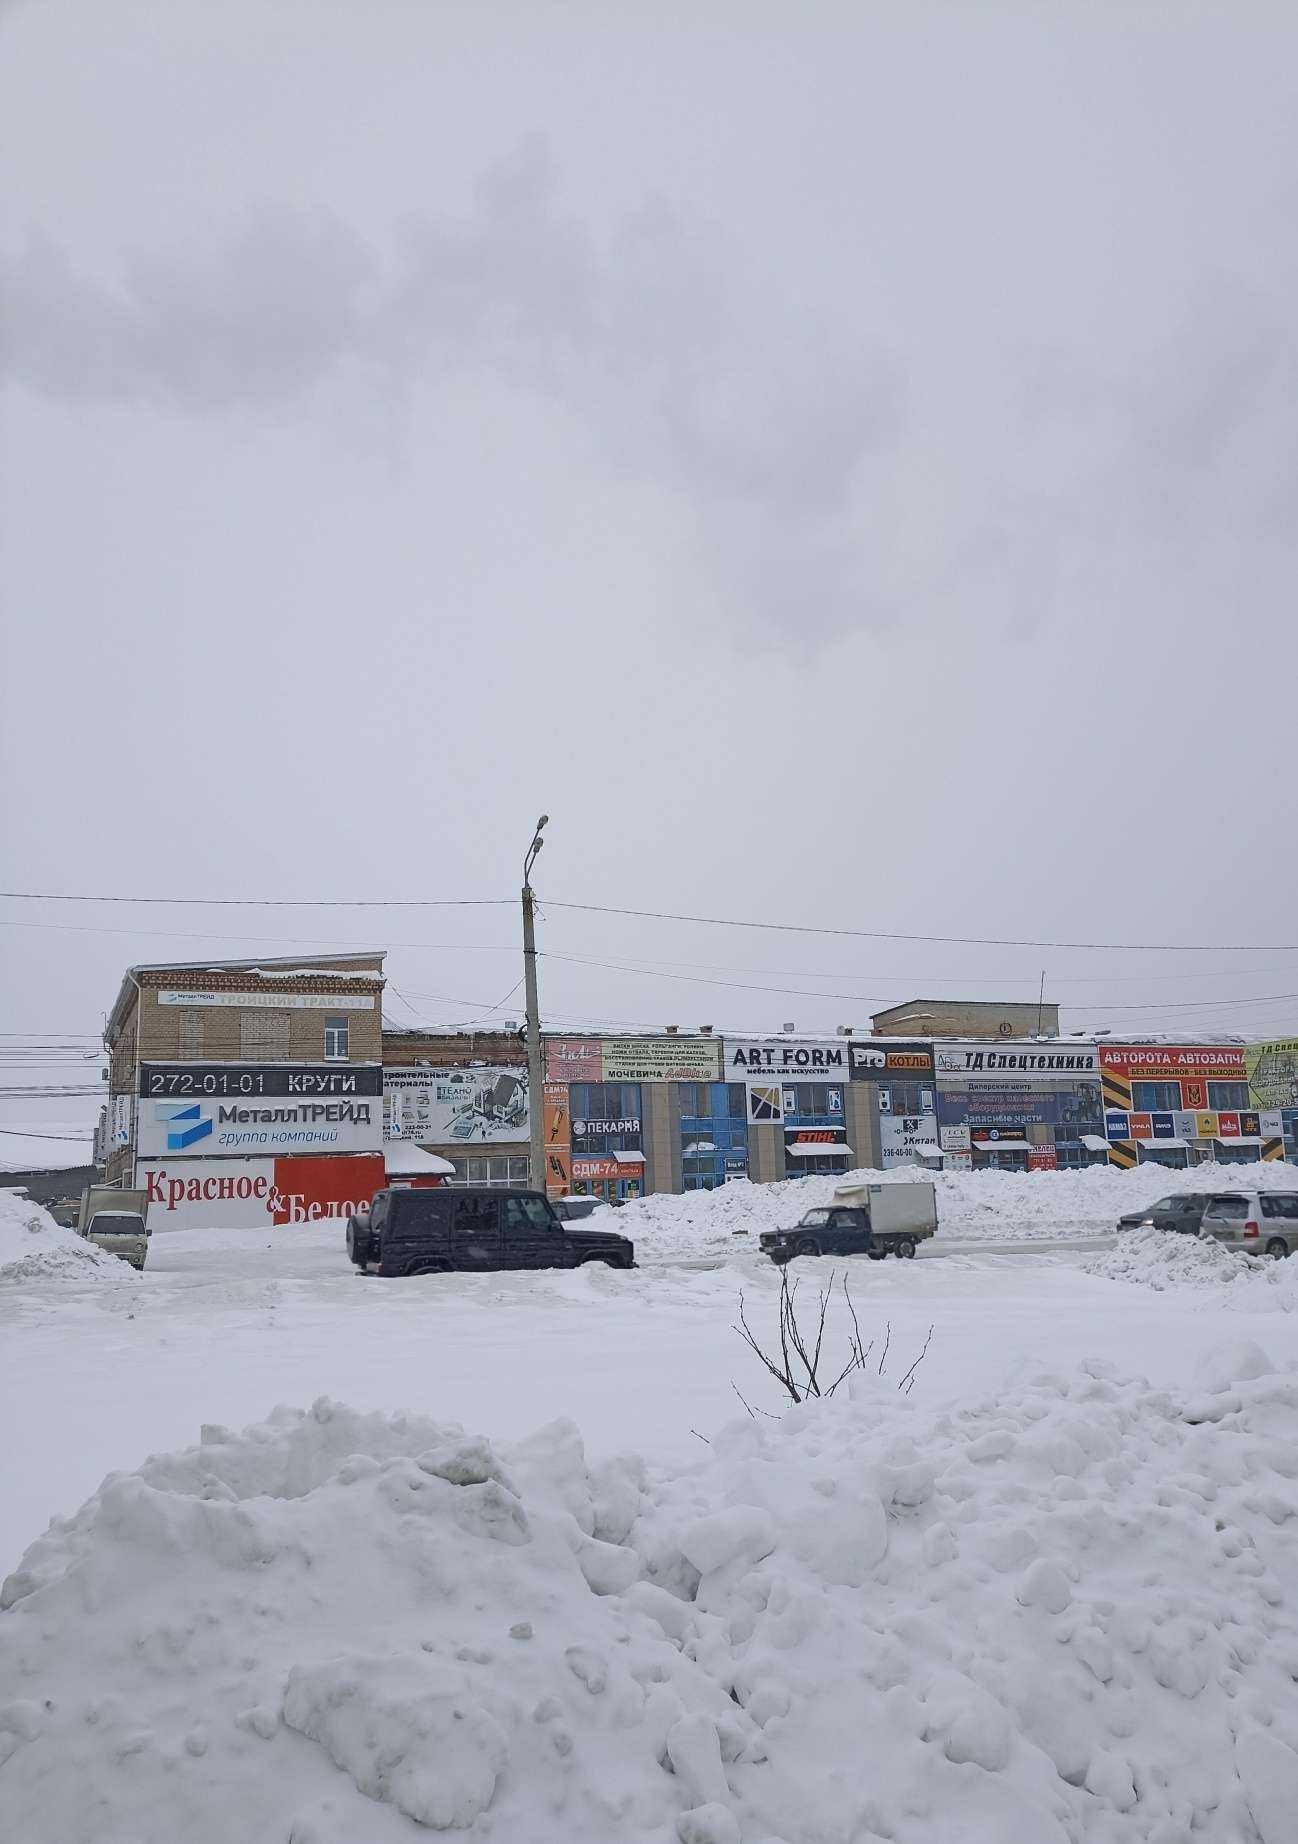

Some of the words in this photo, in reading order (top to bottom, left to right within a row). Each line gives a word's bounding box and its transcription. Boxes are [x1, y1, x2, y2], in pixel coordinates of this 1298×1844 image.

[733, 1049, 775, 1065] ART
[783, 1049, 842, 1066] FORM
[853, 1050, 886, 1068] Pro
[889, 1056, 930, 1067] КОТЛЫ
[966, 1053, 984, 1070] ТД
[988, 1053, 1094, 1070] Спецтехника
[1105, 1052, 1171, 1064] АВТОРОТА
[151, 1075, 264, 1093] 272-01-01
[288, 1076, 356, 1092] КРУГИ
[218, 1102, 371, 1125] МеталлТРЕЙД
[964, 1114, 1012, 1123] Запасные
[1014, 1115, 1042, 1123] части
[588, 1120, 640, 1133] ПЕКАРНЯ
[218, 1131, 267, 1146] группа
[271, 1128, 338, 1143] компаний
[796, 1132, 835, 1143] STIHL
[572, 1163, 618, 1177] СДМ-74
[145, 1171, 268, 1210] Красное
[266, 1186, 286, 1213] &
[288, 1194, 370, 1225] Белое
